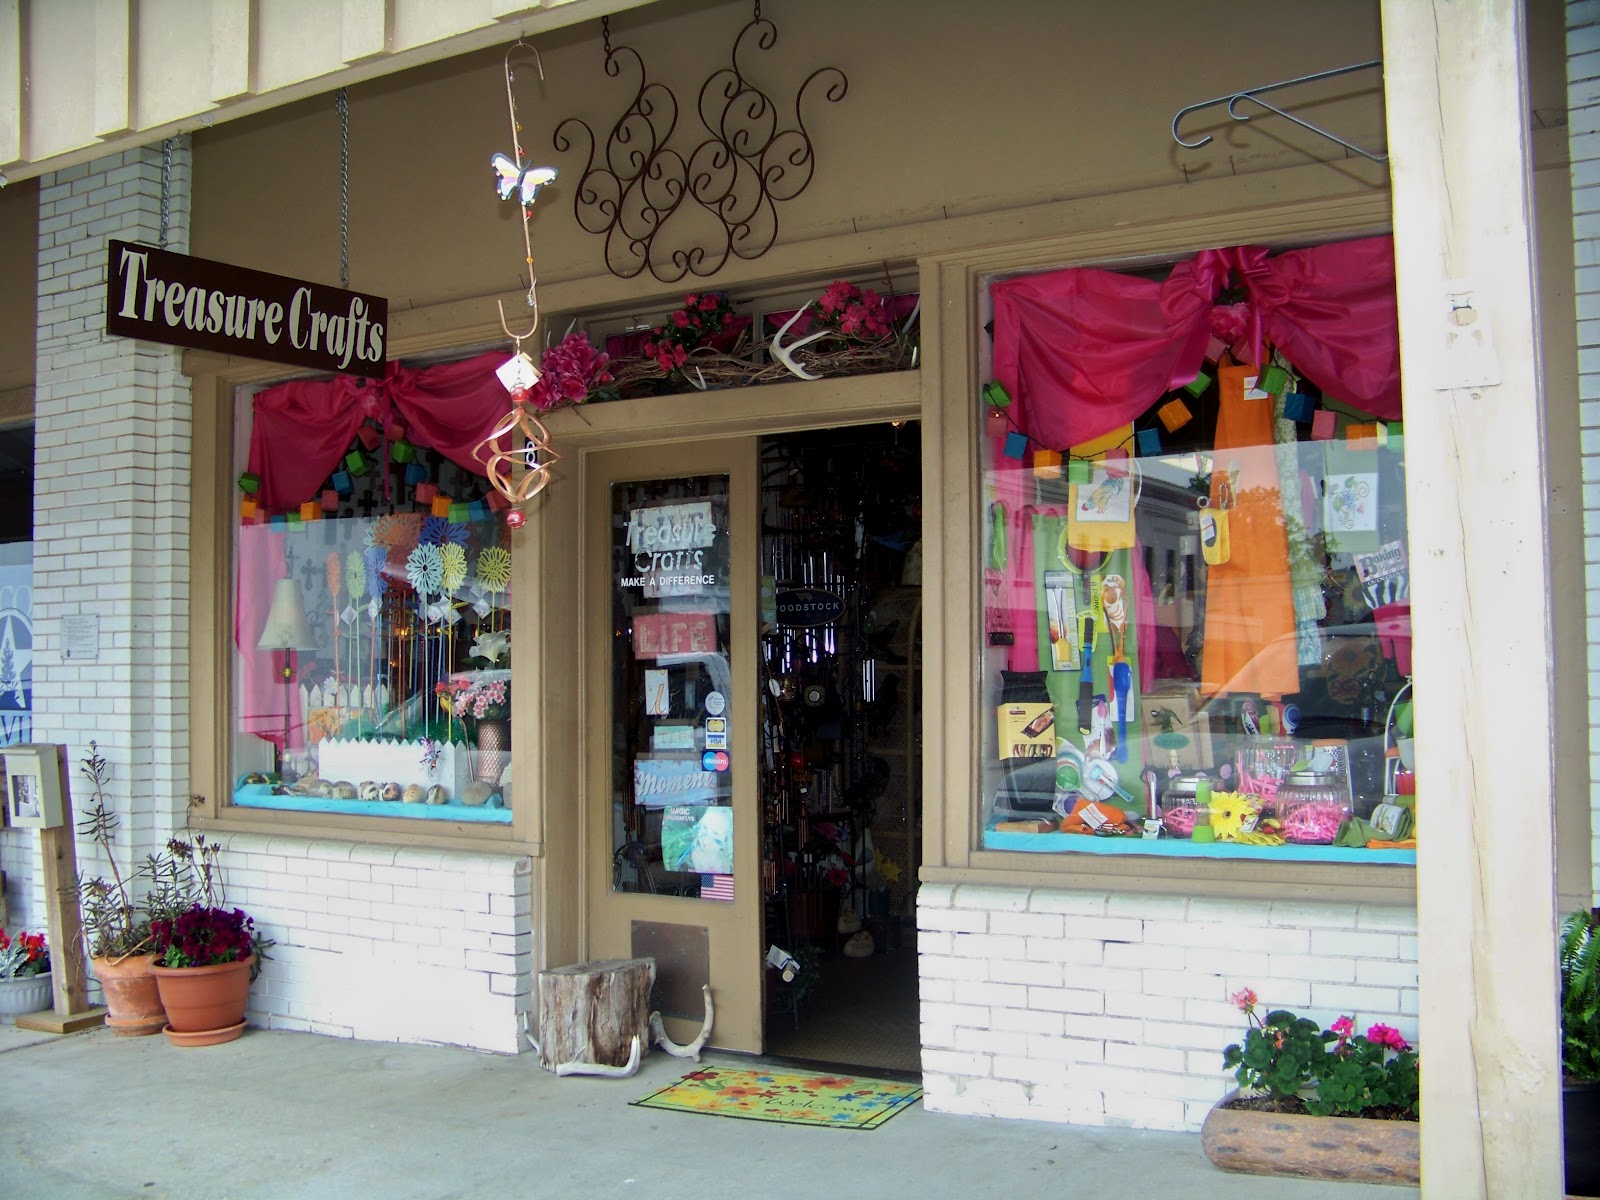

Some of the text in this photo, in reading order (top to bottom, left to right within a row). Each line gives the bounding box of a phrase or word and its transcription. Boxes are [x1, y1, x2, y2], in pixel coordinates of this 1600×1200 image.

[118, 247, 384, 370] Treasure Crafts
[622, 521, 717, 547] Treasure
[620, 574, 715, 588] MAKE A DIFFERENCE
[776, 602, 839, 612] OODSTOCK
[639, 621, 708, 653] LIFE
[669, 807, 690, 815] MAGIC
